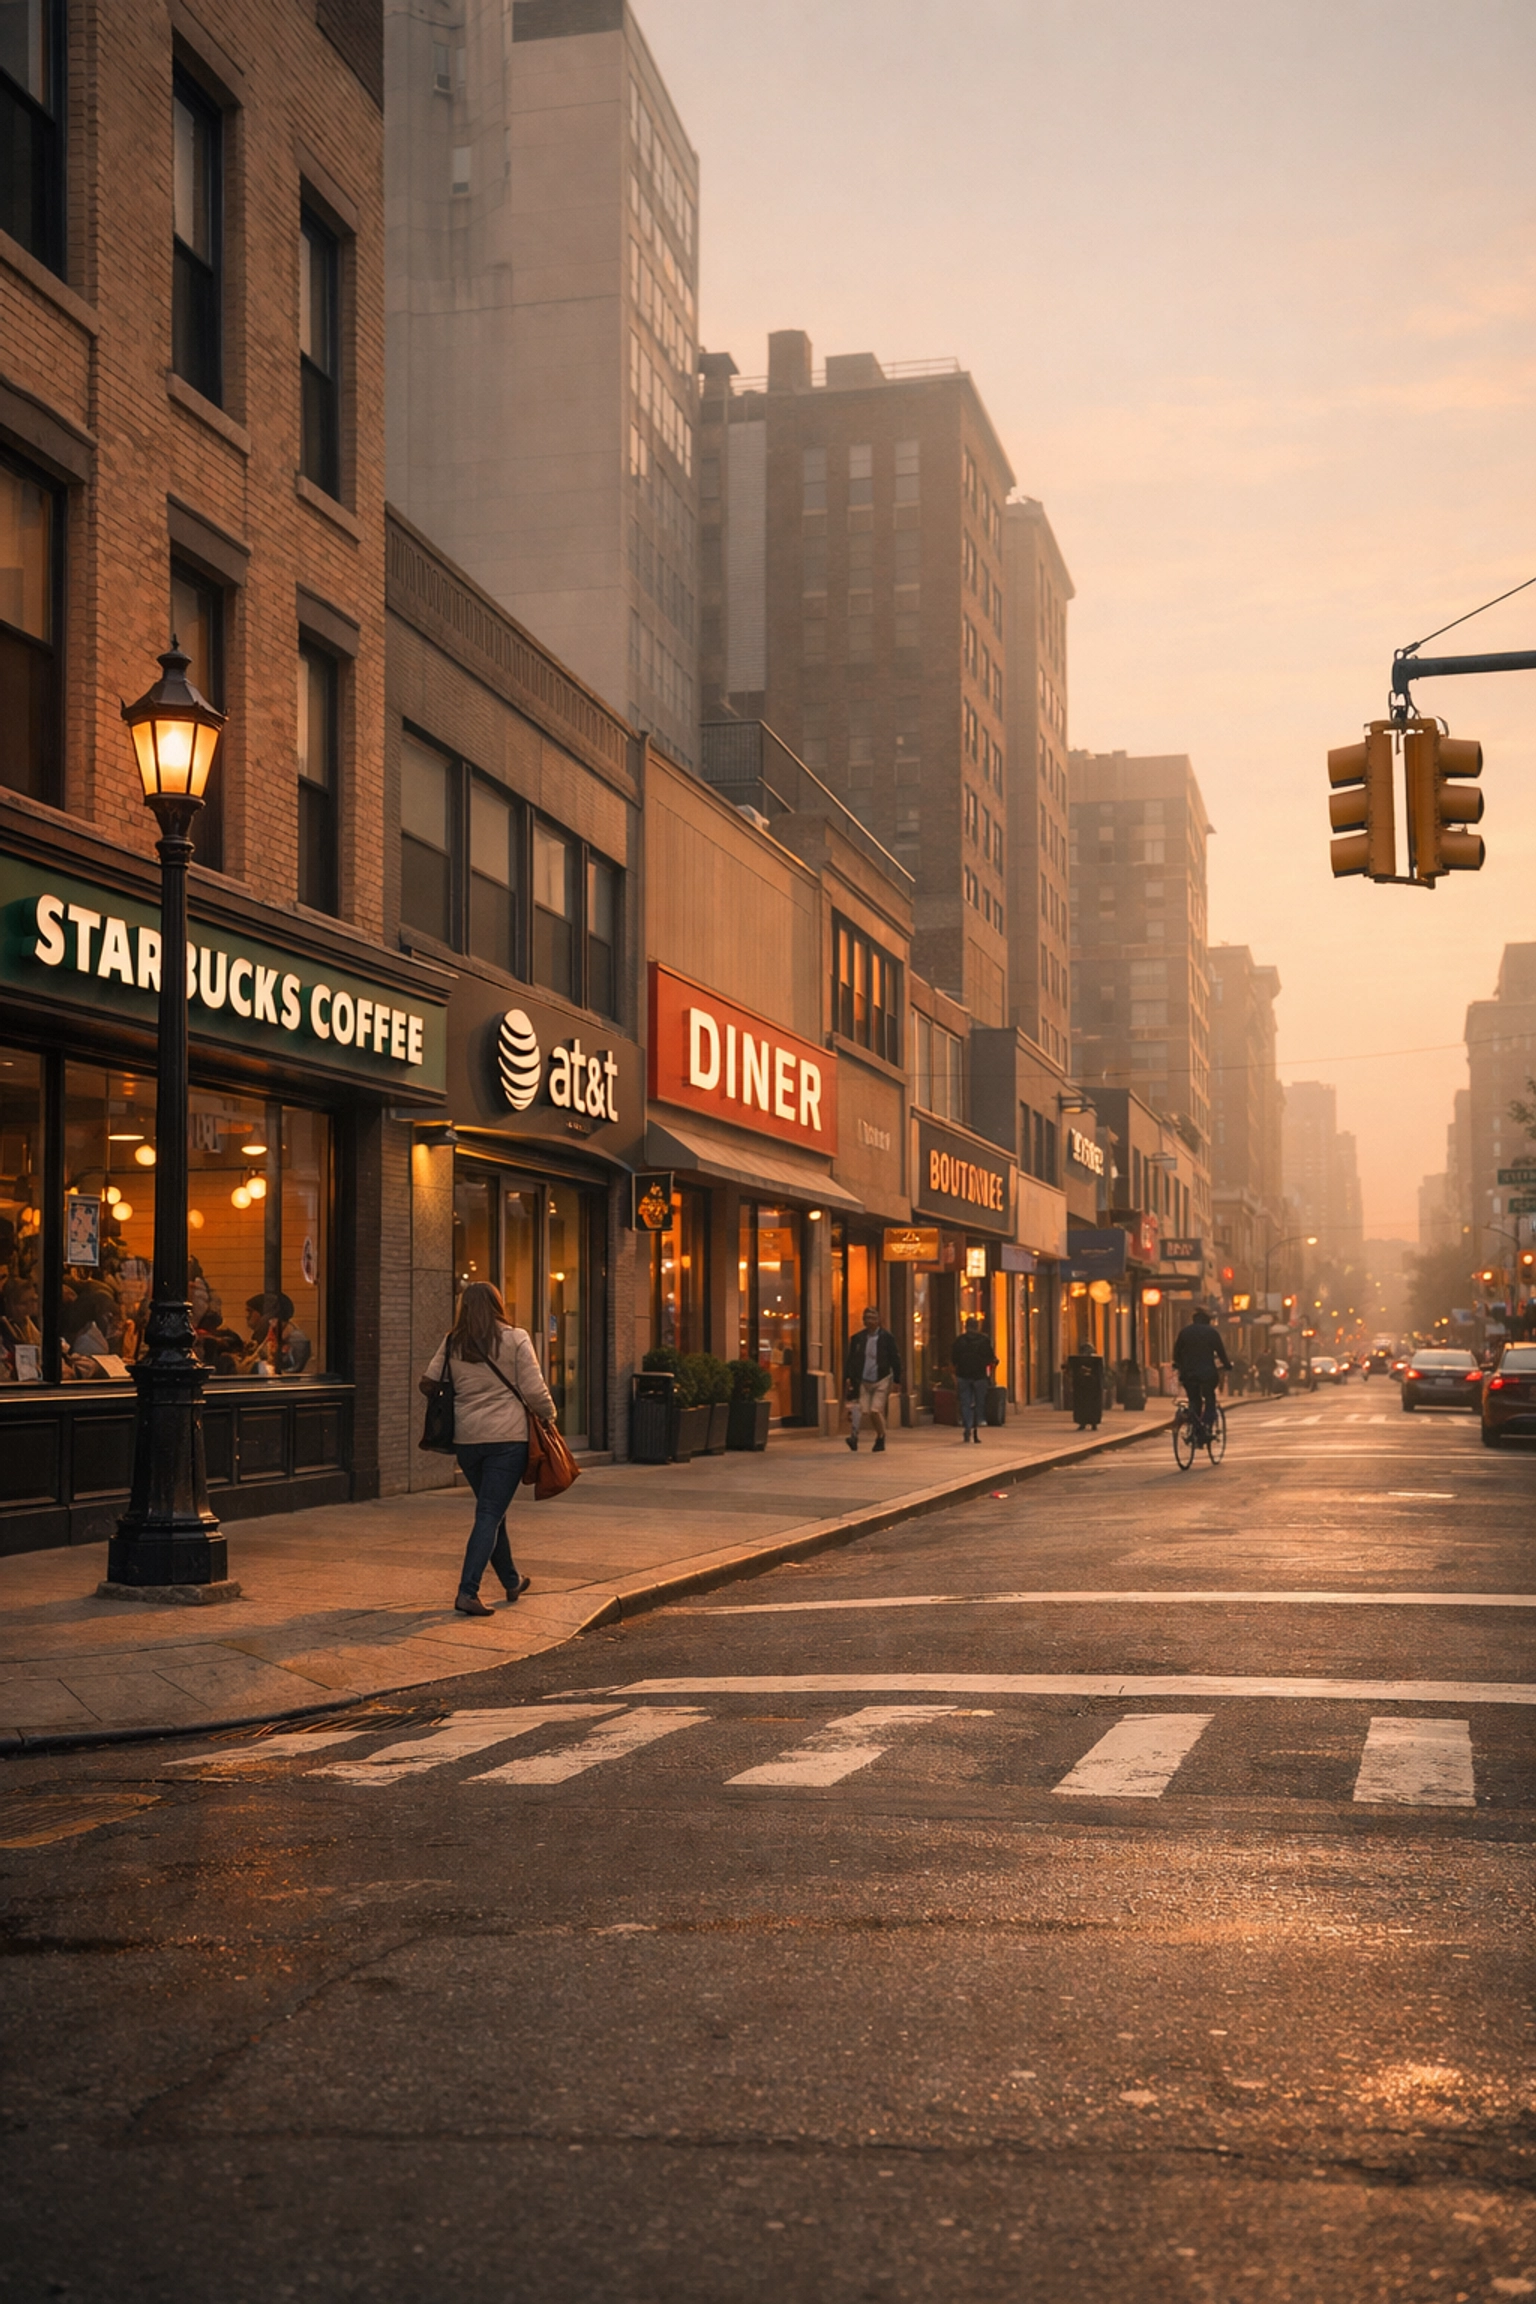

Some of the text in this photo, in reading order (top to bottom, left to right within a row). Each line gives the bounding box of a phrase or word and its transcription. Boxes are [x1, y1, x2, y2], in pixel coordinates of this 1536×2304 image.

[310, 983, 425, 1065] COFFEE
[549, 1038, 619, 1122] at&t
[689, 1007, 822, 1131] DINER
